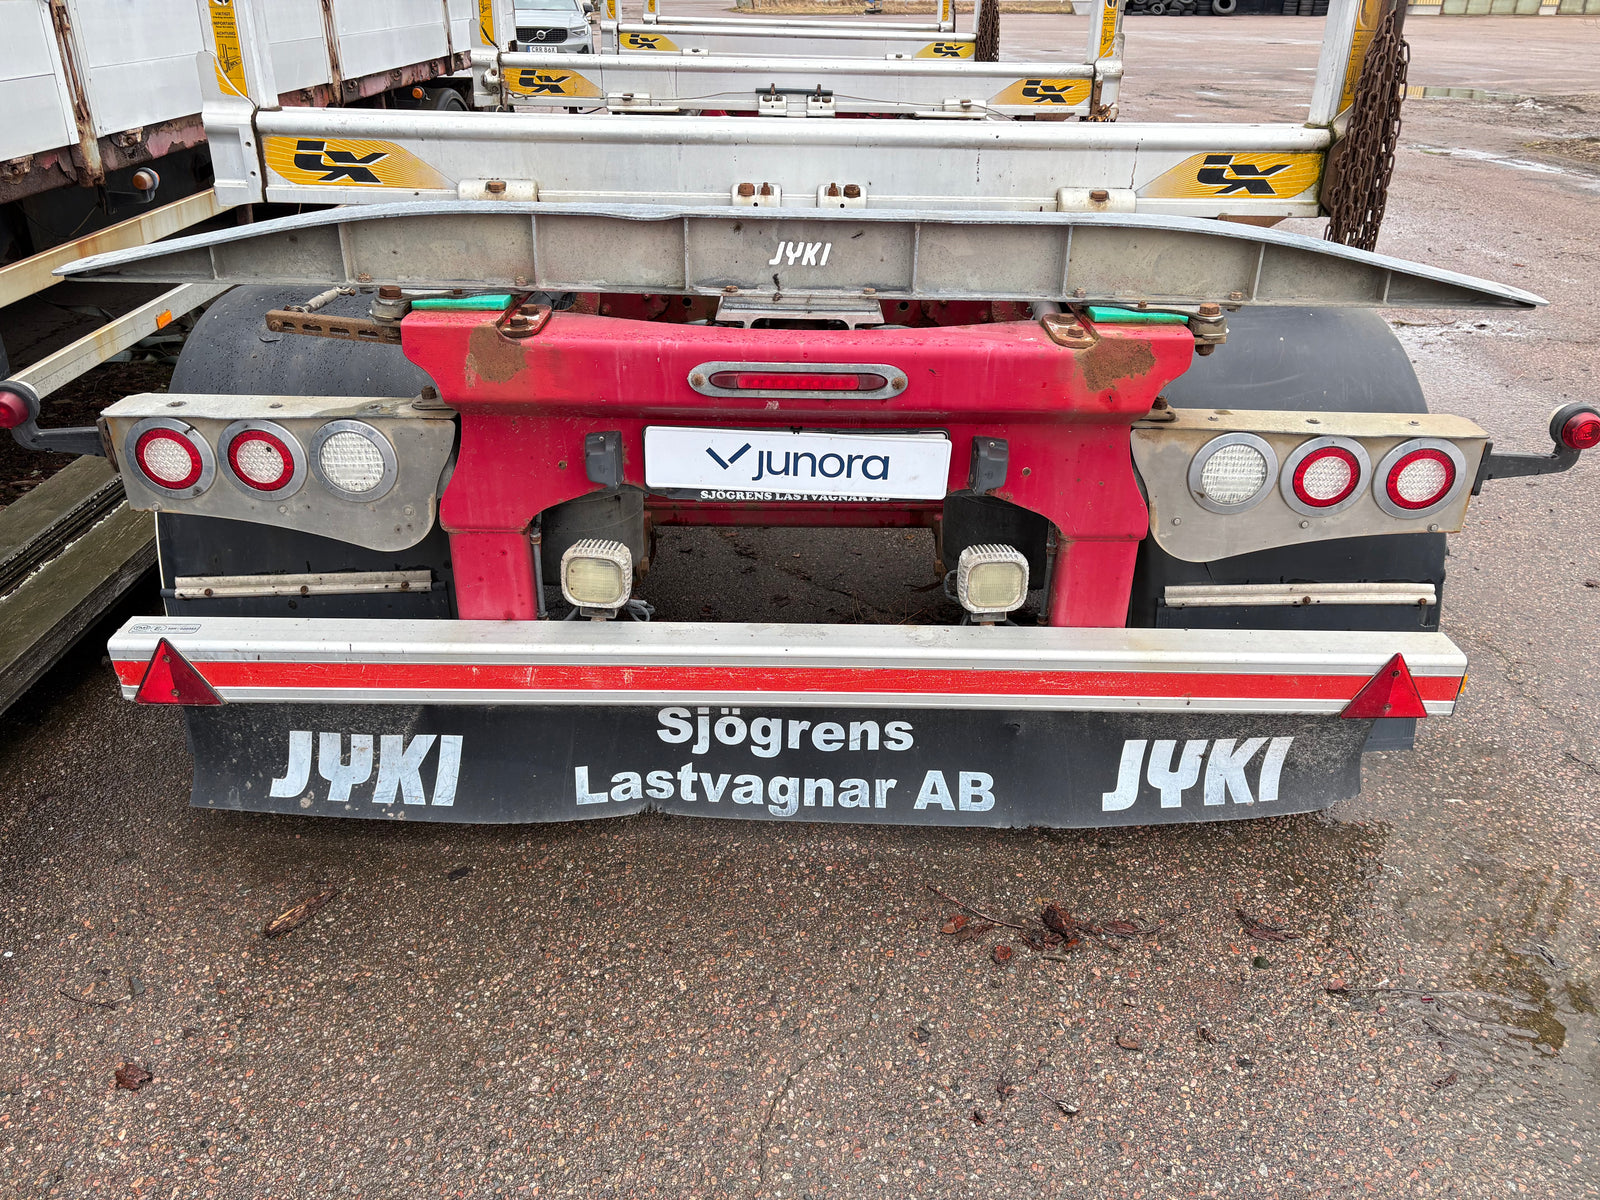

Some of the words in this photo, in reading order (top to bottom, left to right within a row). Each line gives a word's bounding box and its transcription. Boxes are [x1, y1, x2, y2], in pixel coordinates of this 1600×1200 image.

[768, 241, 832, 266] JYKI
[752, 450, 890, 481] junora
[700, 490, 772, 500] SJÖGRENS
[656, 707, 914, 758] Sjögrens
[270, 730, 464, 806] JYKI
[574, 762, 898, 816] Lastvagnar
[913, 770, 996, 812] AB
[1102, 736, 1294, 812] JYKI
